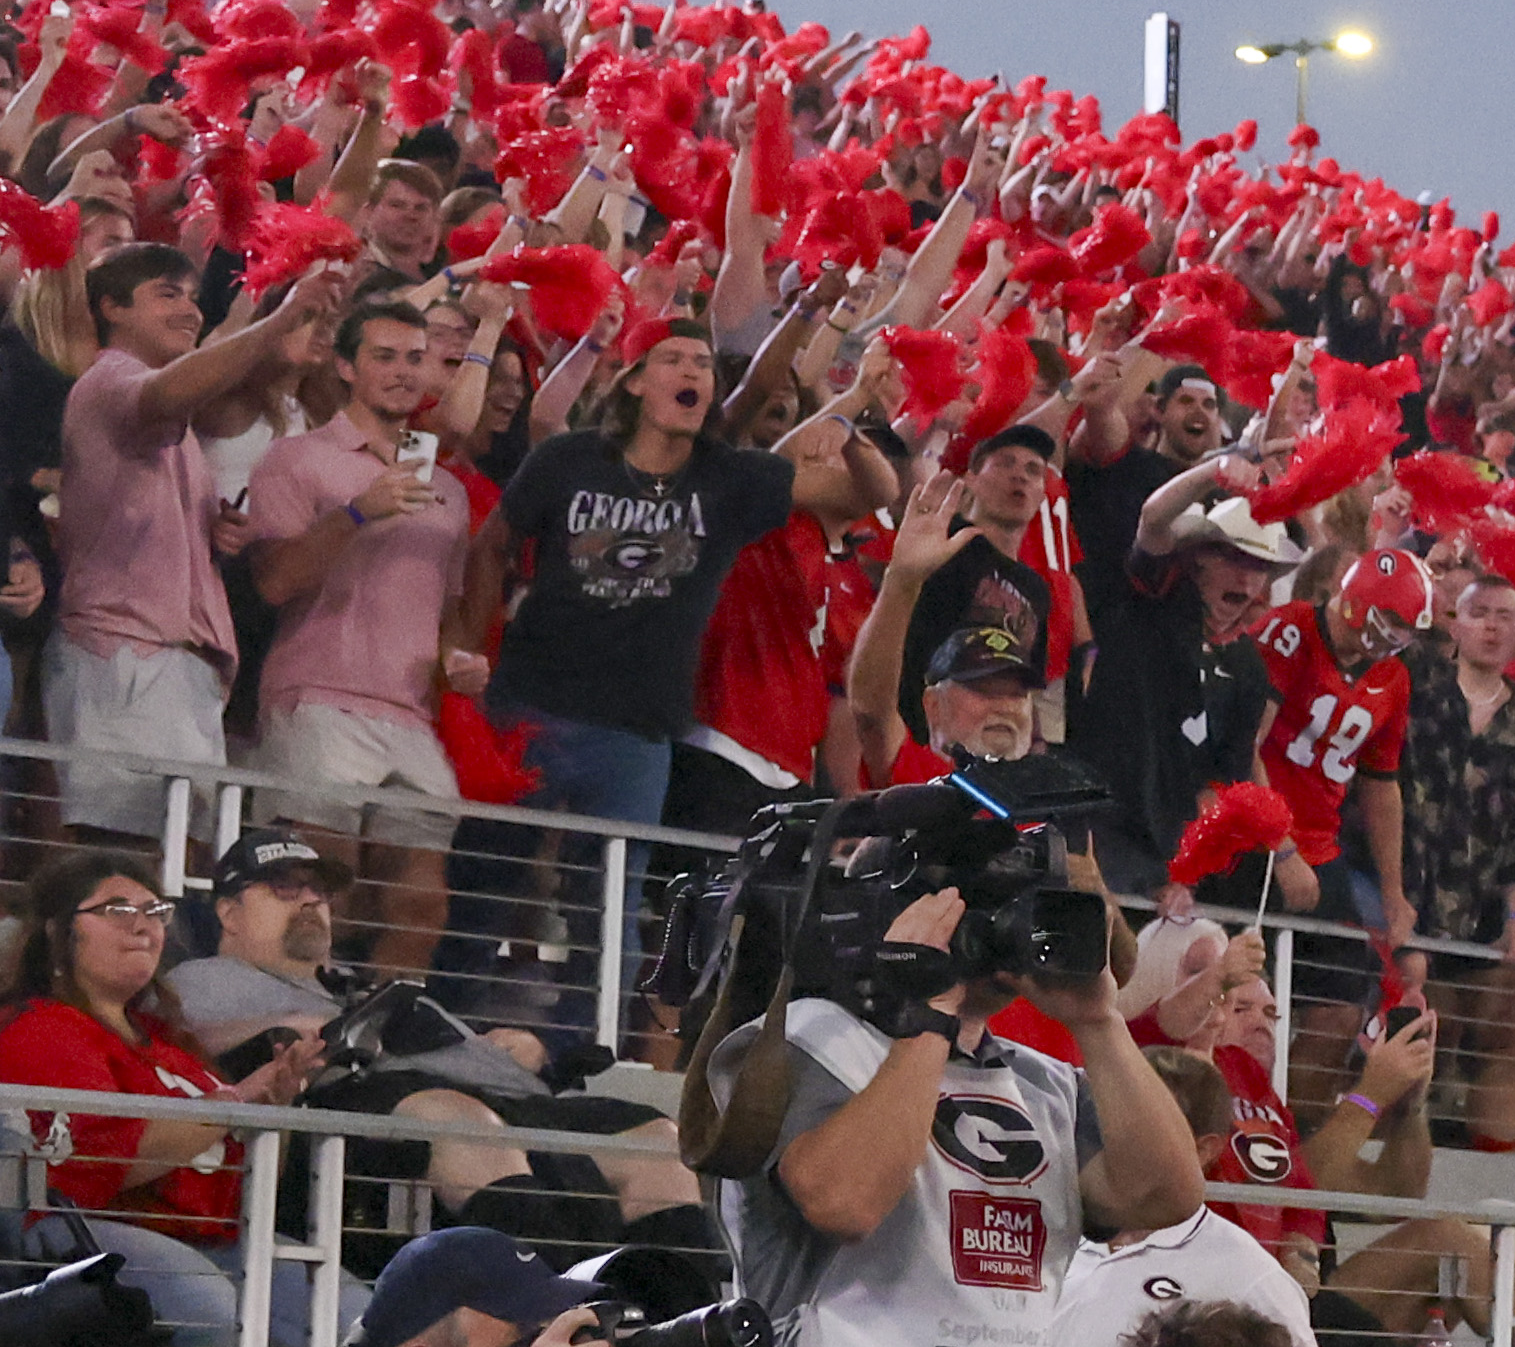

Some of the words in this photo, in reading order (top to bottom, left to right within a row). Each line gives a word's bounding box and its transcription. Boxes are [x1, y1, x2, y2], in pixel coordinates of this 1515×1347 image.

[1257, 617, 1301, 658] 19
[983, 1205, 1034, 1233] FARM
[962, 1228, 1033, 1258] BUREAU
[937, 1318, 1041, 1346] September
